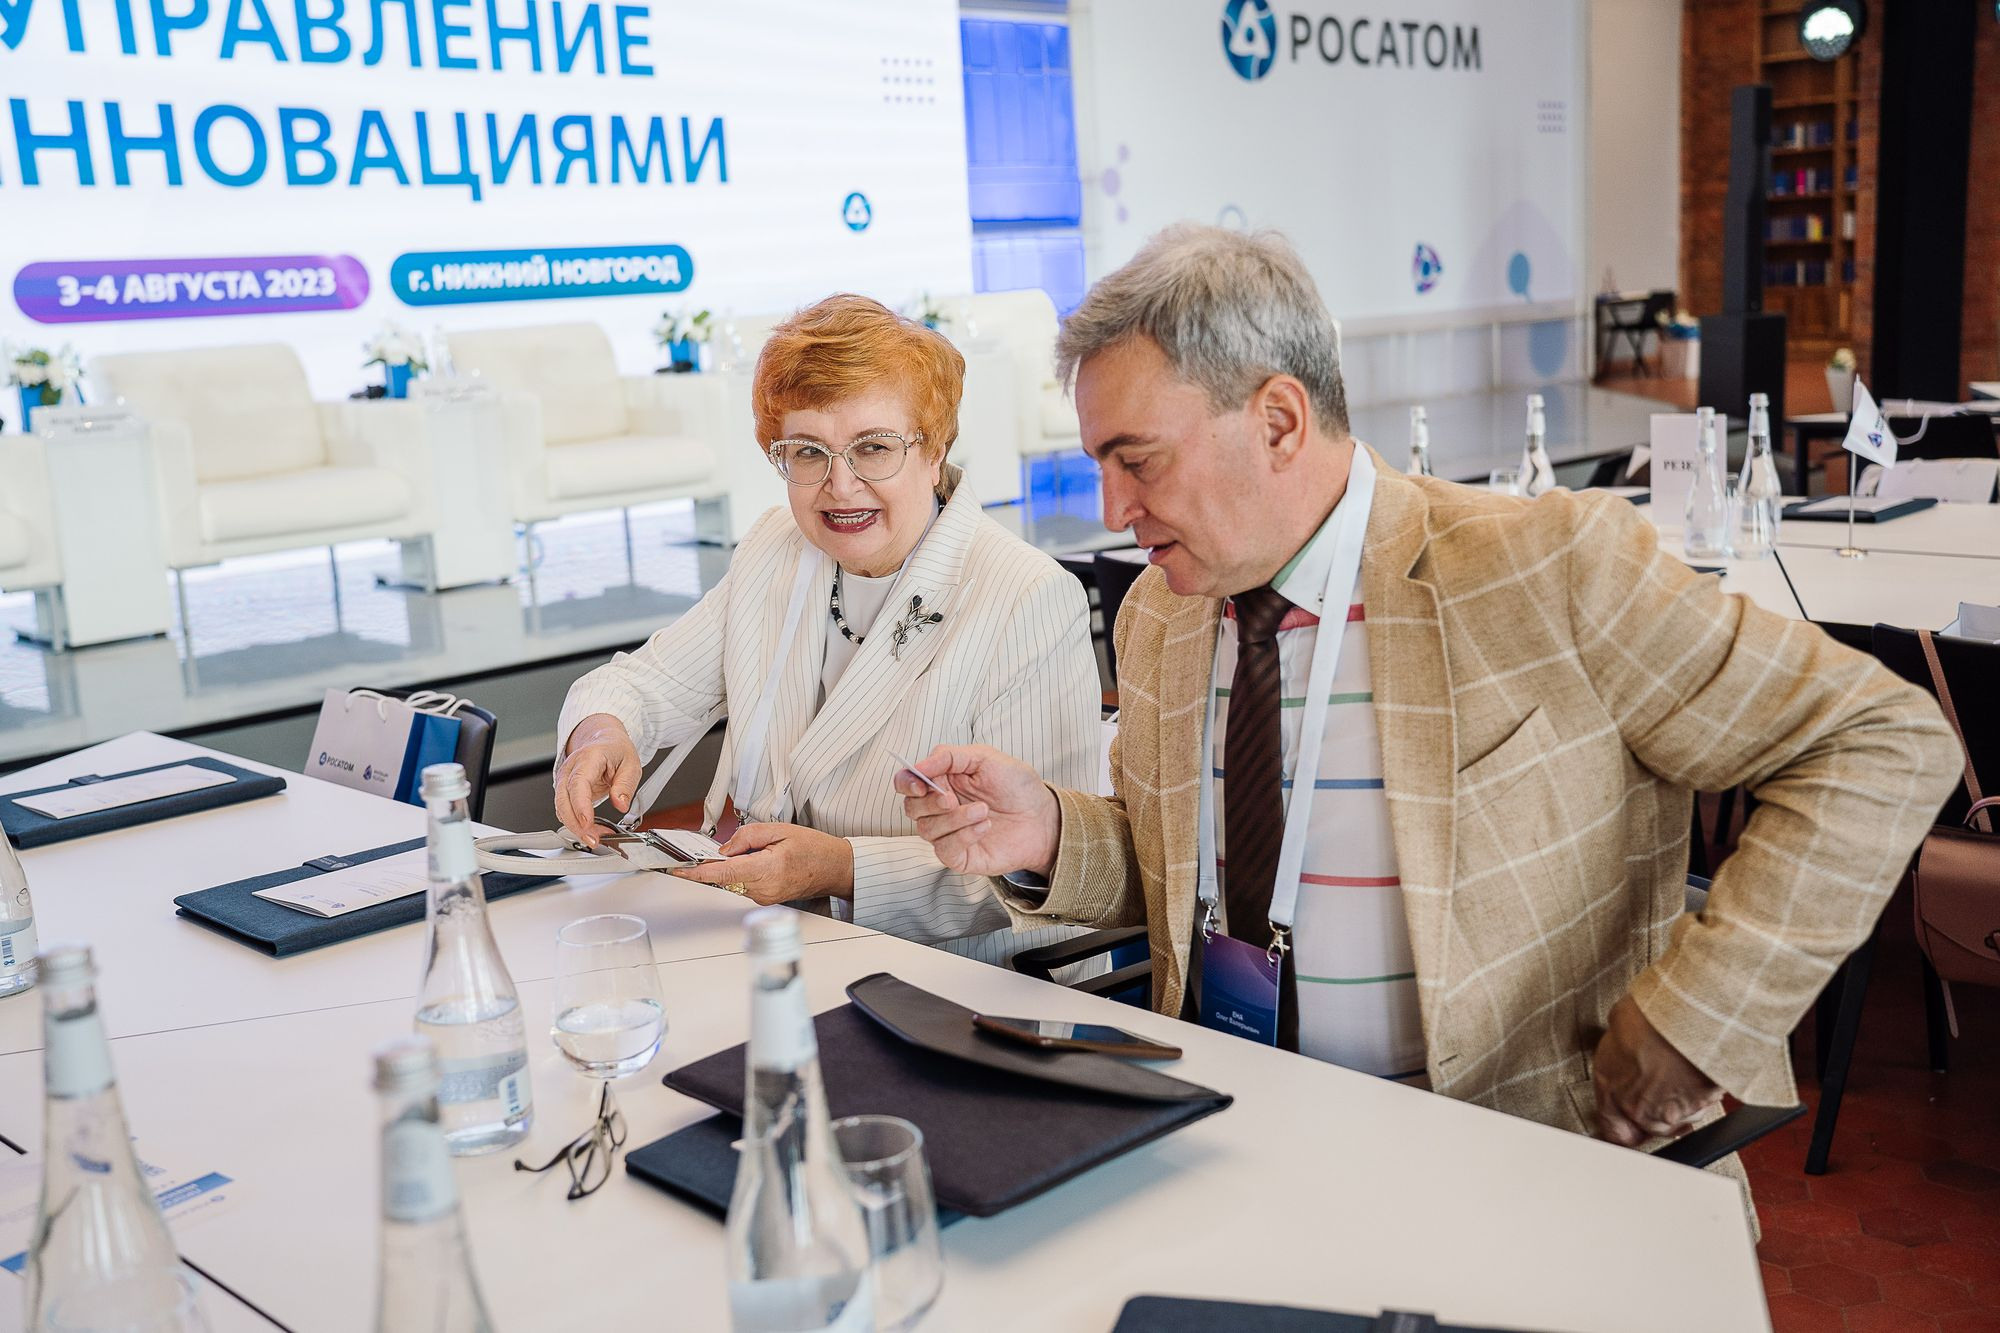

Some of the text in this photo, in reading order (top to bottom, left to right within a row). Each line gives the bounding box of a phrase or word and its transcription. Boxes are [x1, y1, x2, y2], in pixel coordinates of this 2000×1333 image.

[1290, 13, 1482, 70] РОСАТОМ
[0, 97, 729, 202] ННОВАЦИЯМИ
[122, 270, 263, 304] АВГУСТА
[263, 267, 337, 298] 2023
[408, 254, 682, 293] г. НИЖНИЙ НОВГОРОД
